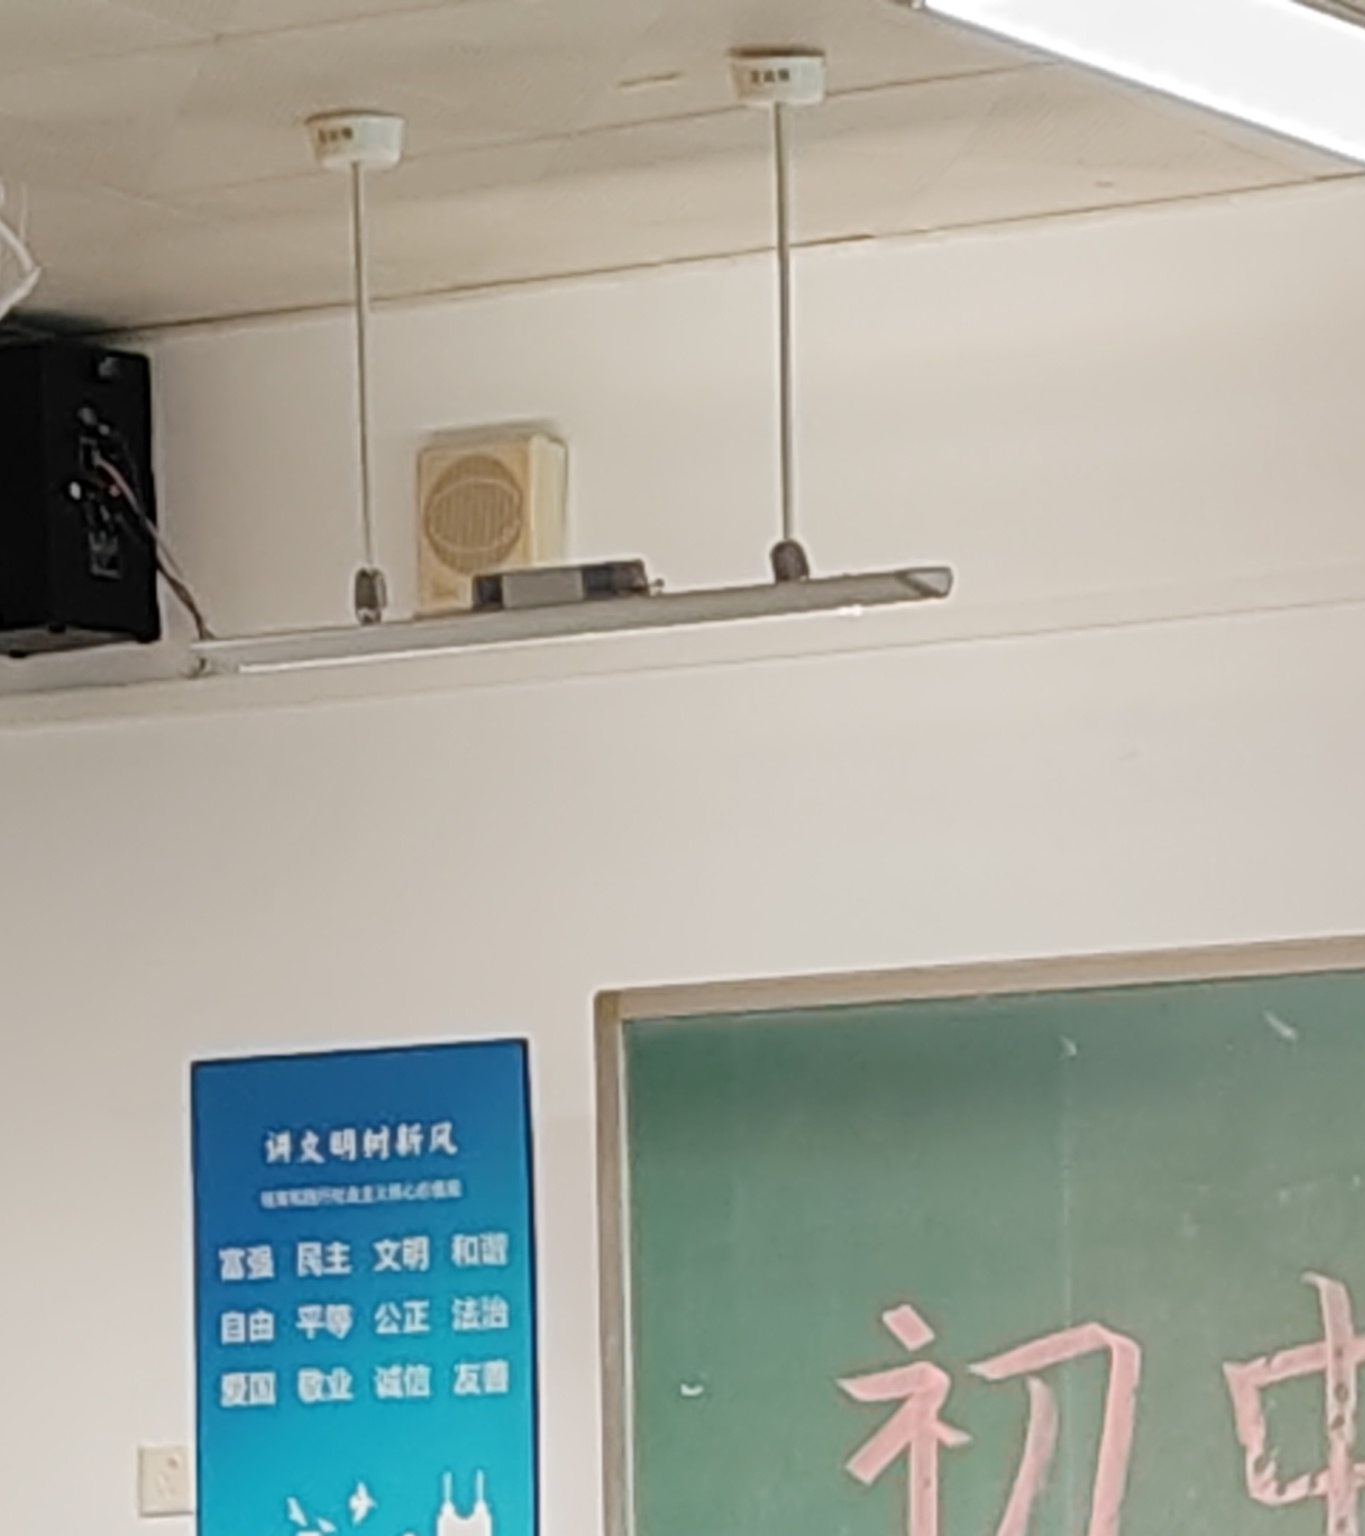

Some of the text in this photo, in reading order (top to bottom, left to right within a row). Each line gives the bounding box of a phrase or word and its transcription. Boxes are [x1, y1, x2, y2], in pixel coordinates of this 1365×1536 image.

[218, 1231, 510, 1282] 富强 民主 文明 和谐
[220, 1294, 510, 1345] 自由 平等 公正 法治
[298, 1367, 354, 1404] 敬业
[375, 1363, 432, 1399] 诚信
